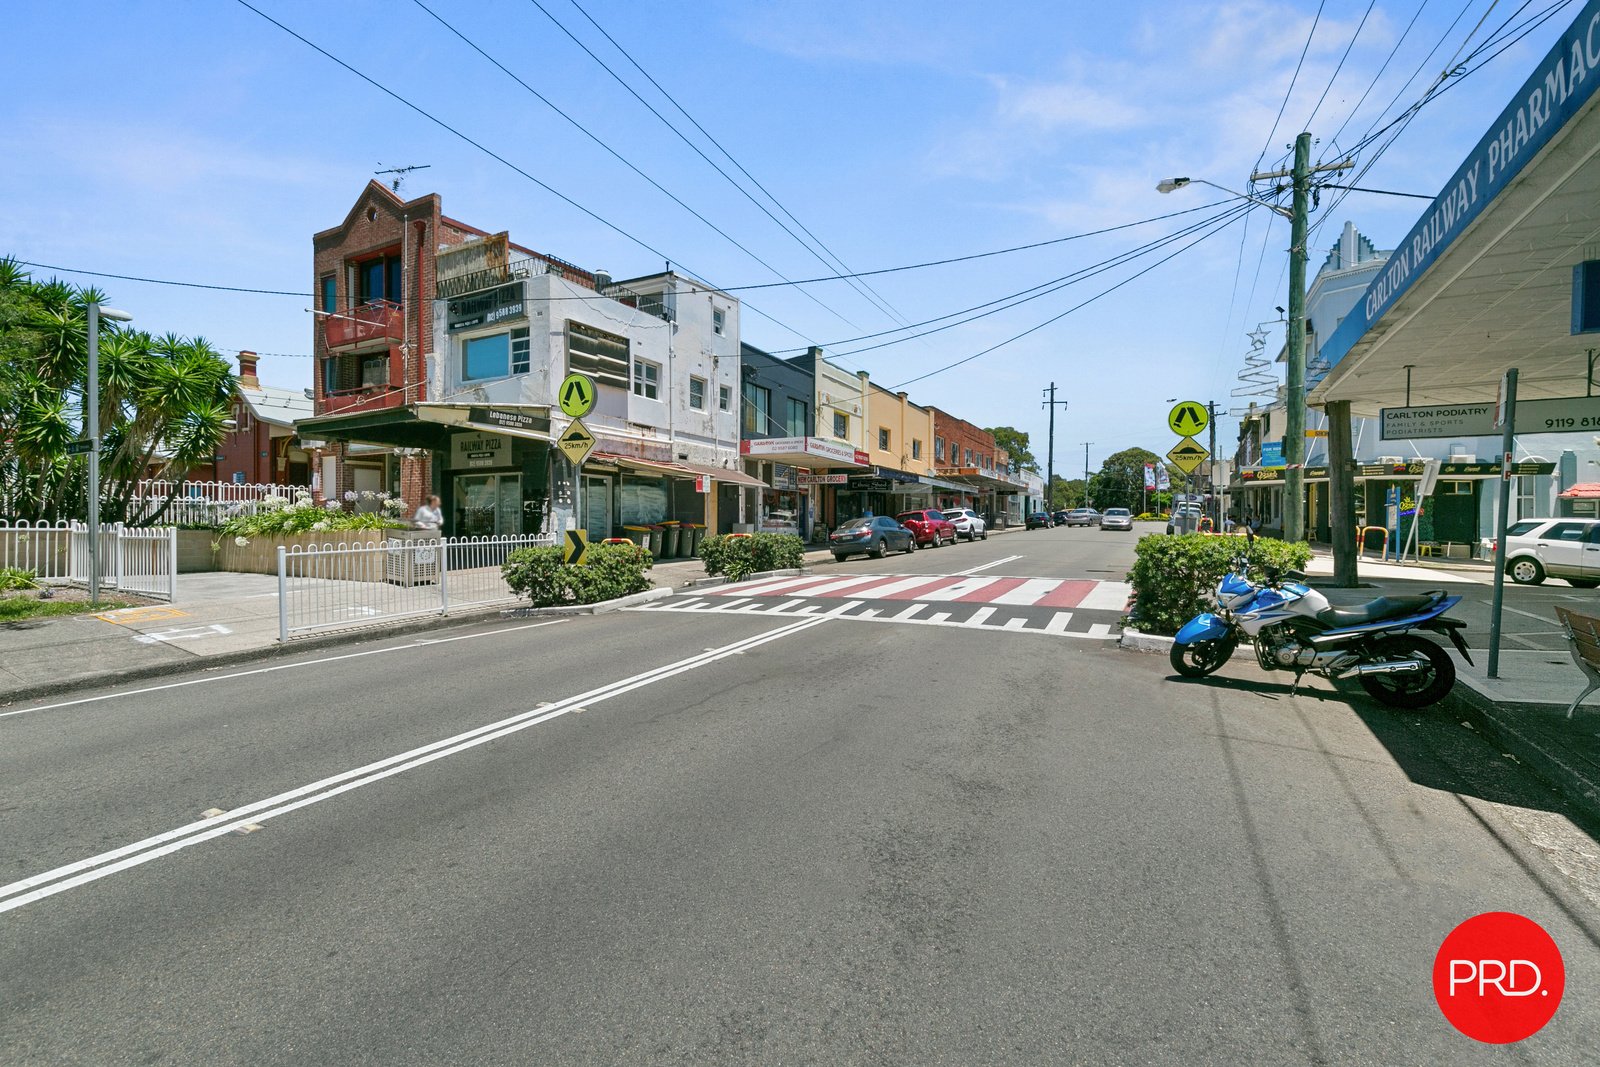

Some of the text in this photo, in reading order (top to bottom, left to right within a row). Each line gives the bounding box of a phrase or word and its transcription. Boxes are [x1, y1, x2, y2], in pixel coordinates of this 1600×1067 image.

[1366, 247, 1409, 320] CARLTON
[1413, 161, 1479, 268] RAILWAY
[490, 410, 532, 424] Lebanese Pizza
[1386, 408, 1488, 420] CARLTON PODIATRY
[1386, 420, 1416, 428] FAMILY
[1545, 418, 1575, 428] 9119
[460, 438, 502, 452] RAILWAY PIZZA
